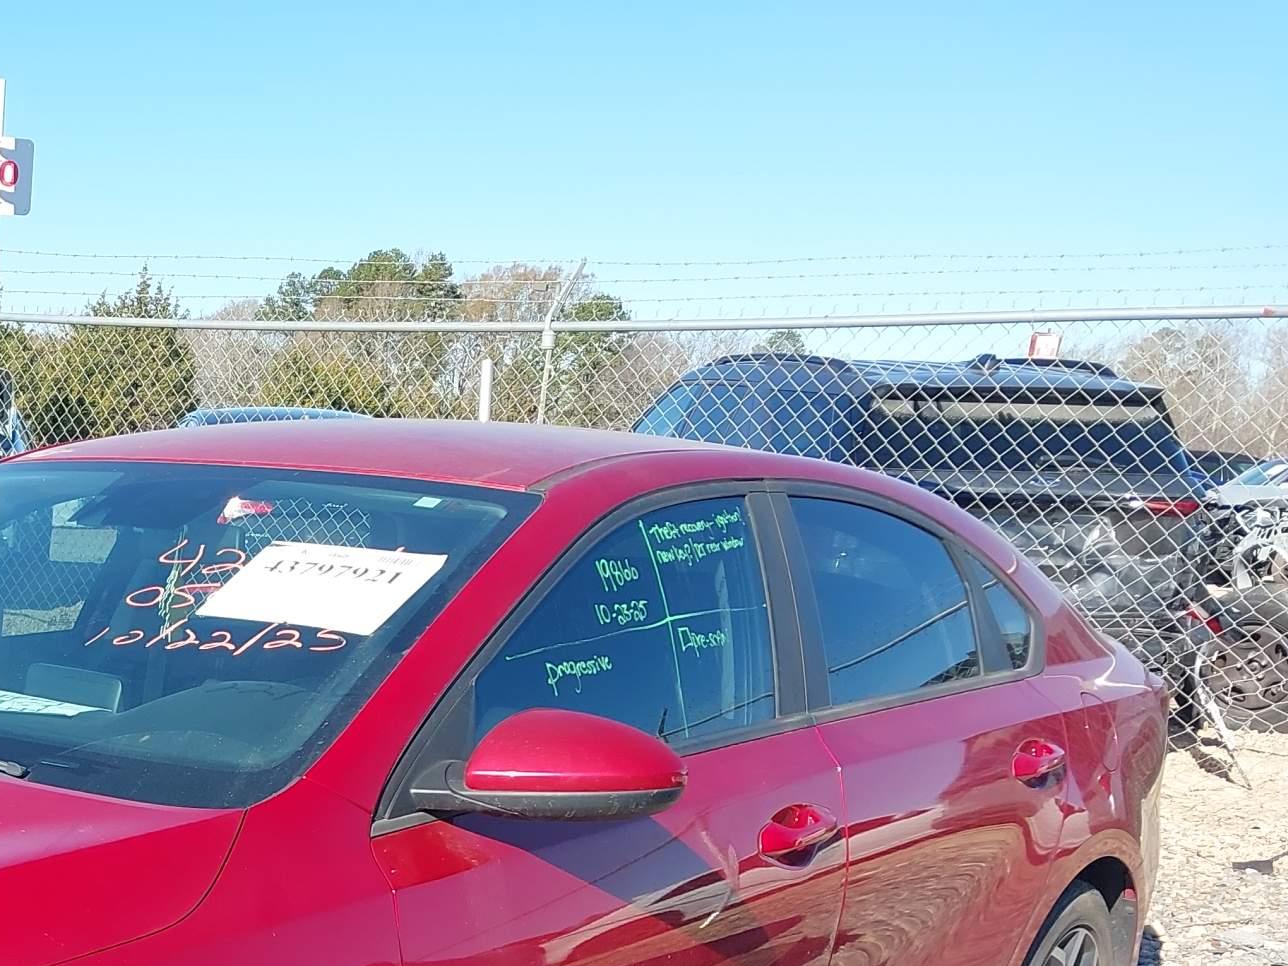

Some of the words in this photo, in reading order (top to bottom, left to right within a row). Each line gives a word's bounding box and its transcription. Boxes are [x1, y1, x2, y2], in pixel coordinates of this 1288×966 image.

[264, 560, 405, 585] 43797921
[595, 558, 639, 592] 19866
[594, 600, 648, 624] 10-23-25
[84, 619, 347, 656] 10/22/25
